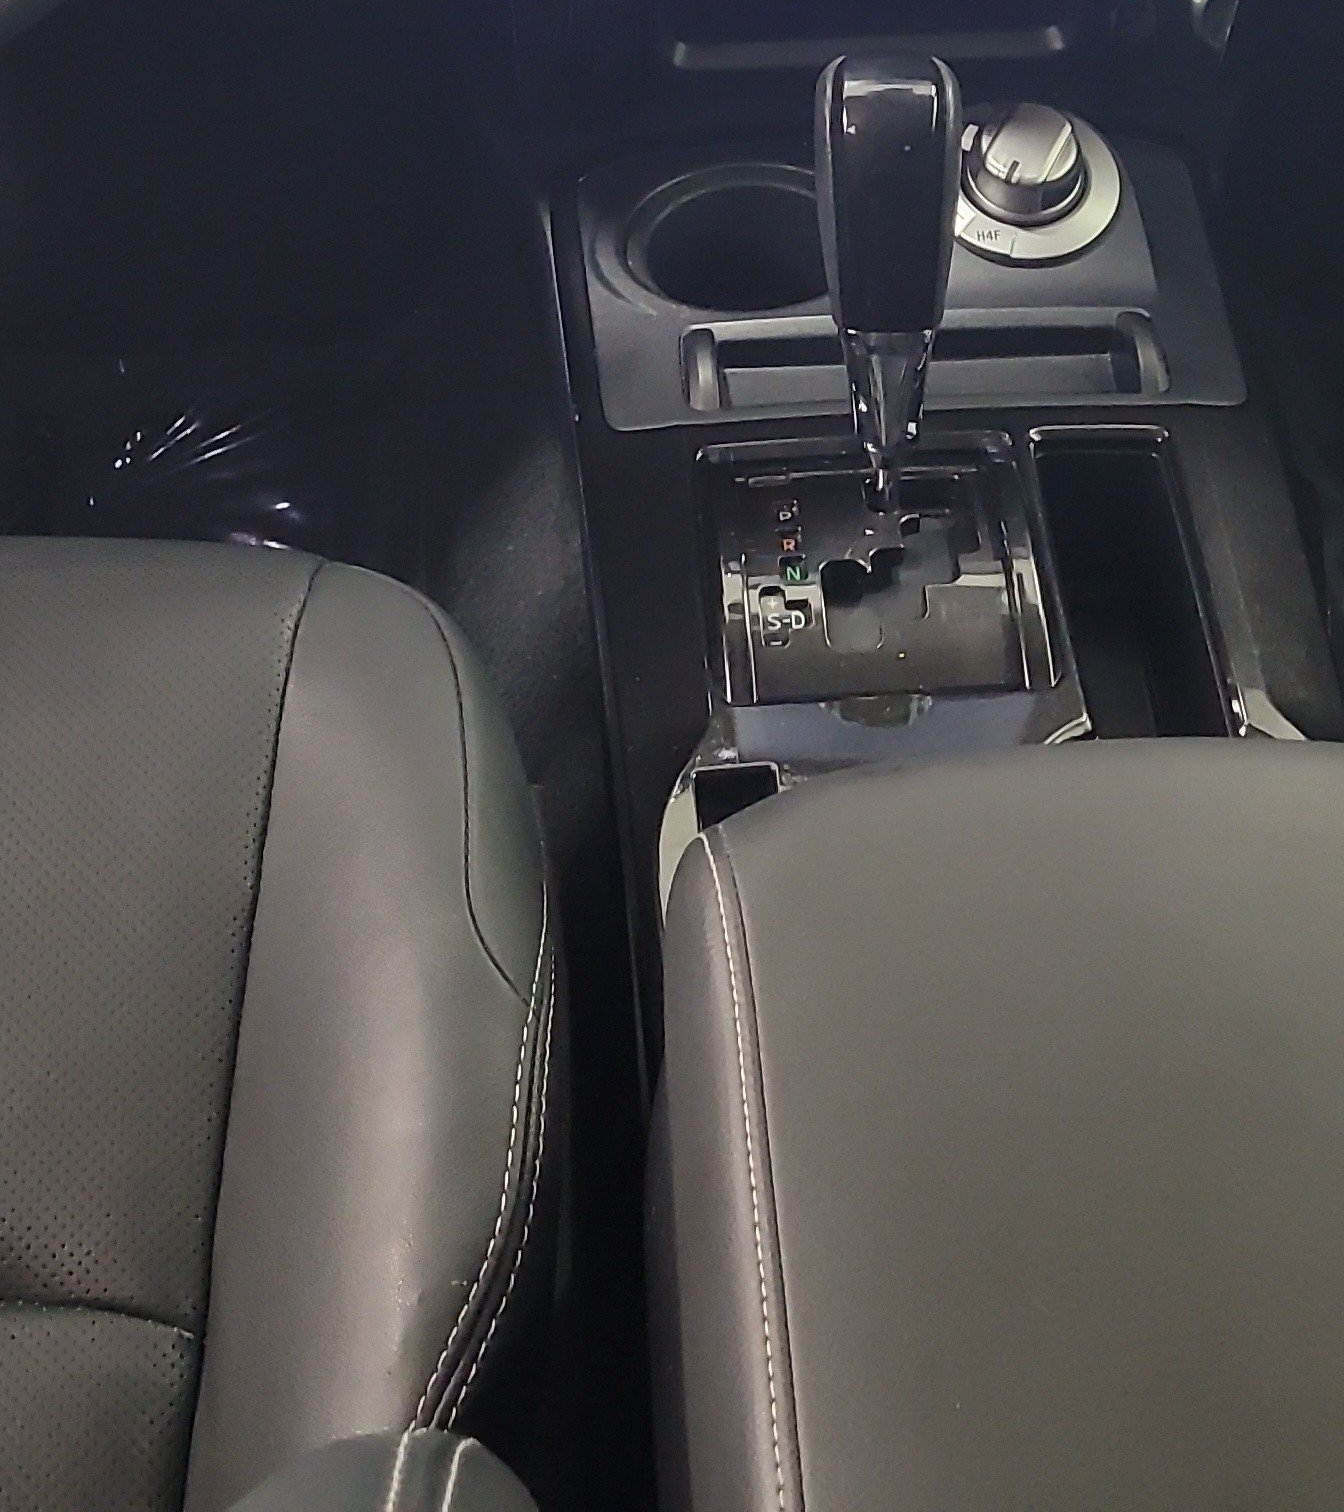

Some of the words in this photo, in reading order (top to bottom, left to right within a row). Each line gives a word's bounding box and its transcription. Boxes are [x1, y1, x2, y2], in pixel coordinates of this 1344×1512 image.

[976, 229, 1002, 242] H4F
[779, 510, 793, 522] P
[782, 538, 796, 552] R
[786, 565, 802, 582] N
